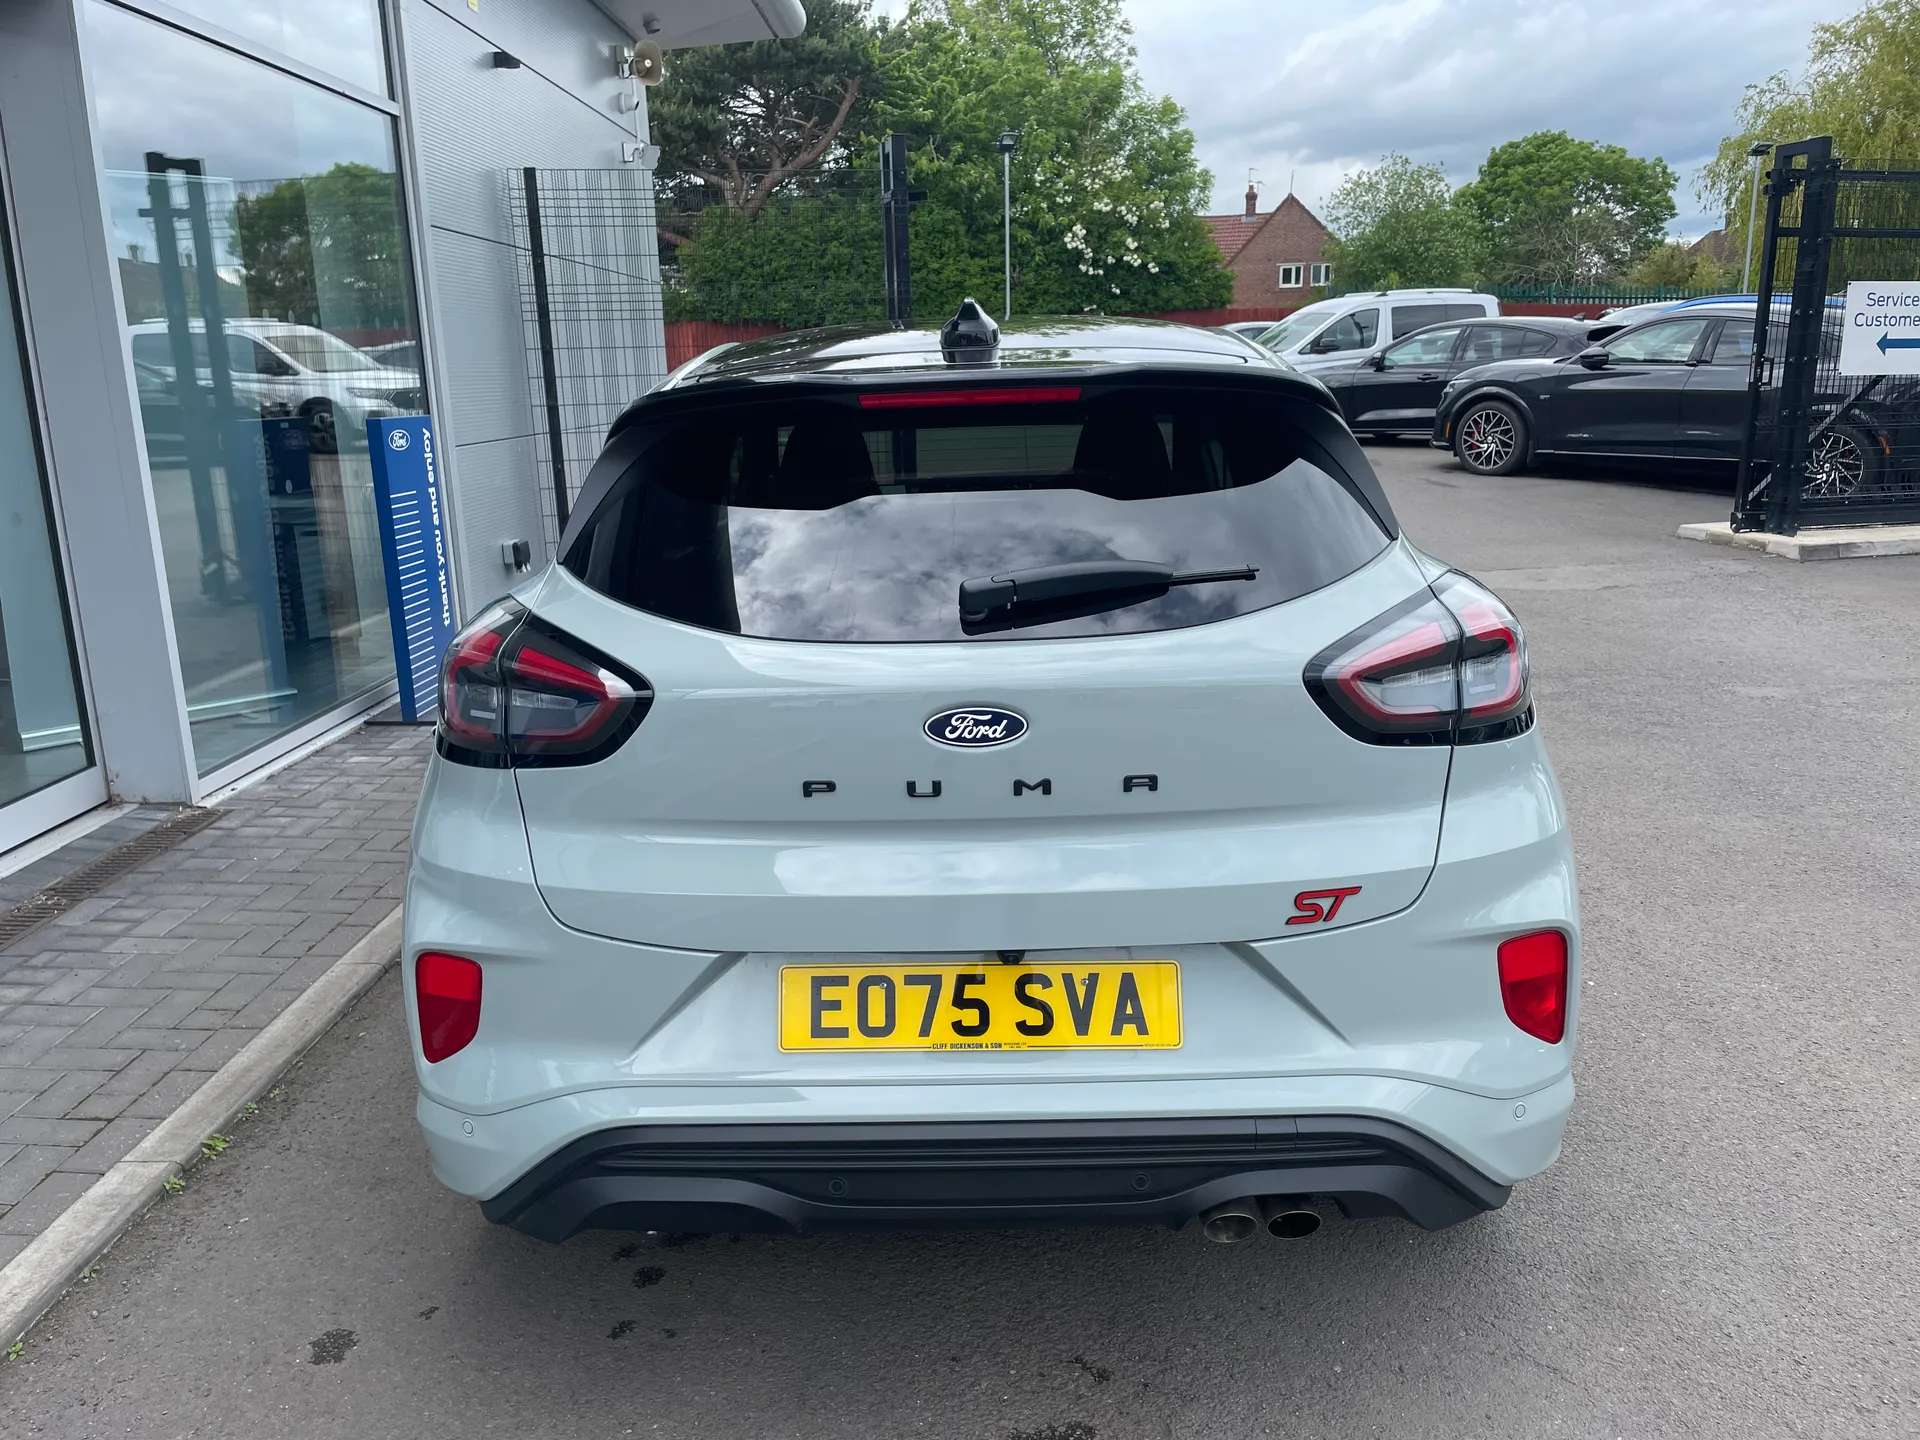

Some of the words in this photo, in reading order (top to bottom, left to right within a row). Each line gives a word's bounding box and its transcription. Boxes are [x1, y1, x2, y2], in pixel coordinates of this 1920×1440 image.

[1866, 292, 1920, 307] Service
[392, 432, 407, 448] Ford
[422, 427, 435, 484] enjoy
[428, 487, 440, 527] and
[434, 529, 445, 567] you
[439, 568, 451, 628] thank
[944, 713, 1008, 739] Ford
[802, 773, 1159, 798] PUMA
[1285, 886, 1362, 925] ST
[810, 973, 990, 1039] EO75
[1014, 972, 1149, 1037] SVA
